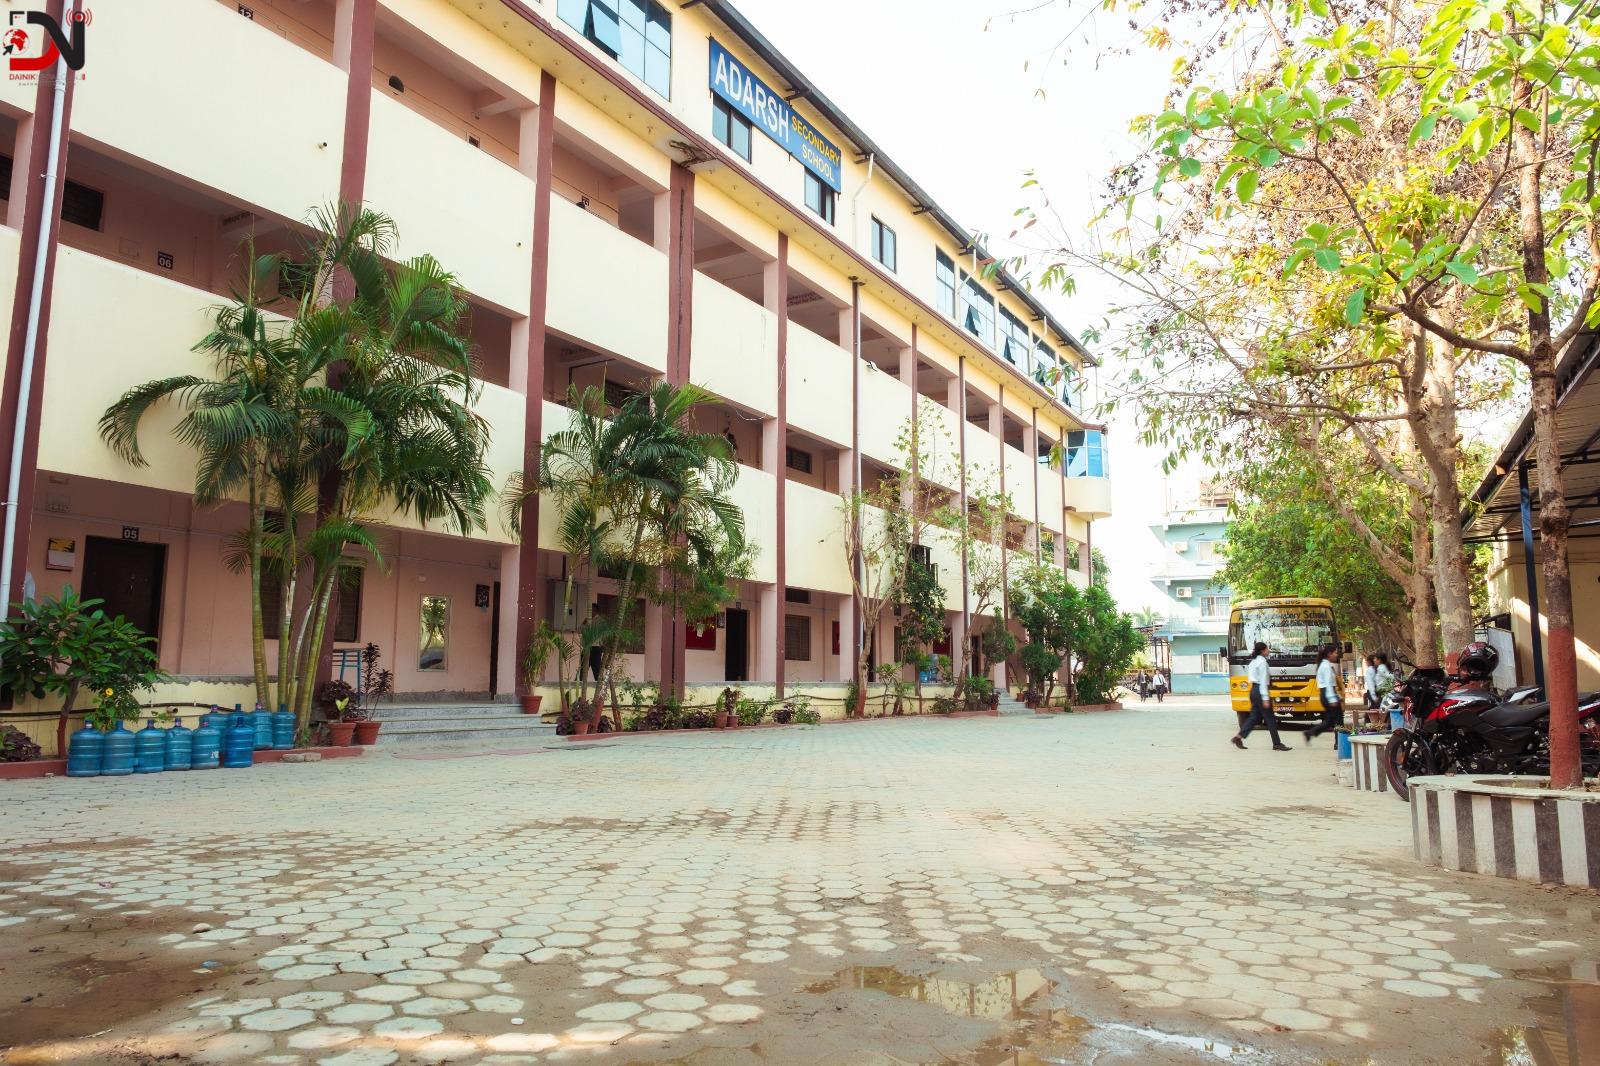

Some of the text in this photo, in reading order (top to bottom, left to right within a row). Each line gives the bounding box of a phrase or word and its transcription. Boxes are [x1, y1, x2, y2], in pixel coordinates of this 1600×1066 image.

[714, 53, 790, 143] ADARSH
[791, 116, 841, 167] SECONDARY
[802, 144, 835, 182] SCHOOL
[159, 257, 172, 268] 06
[124, 529, 137, 539] 05
